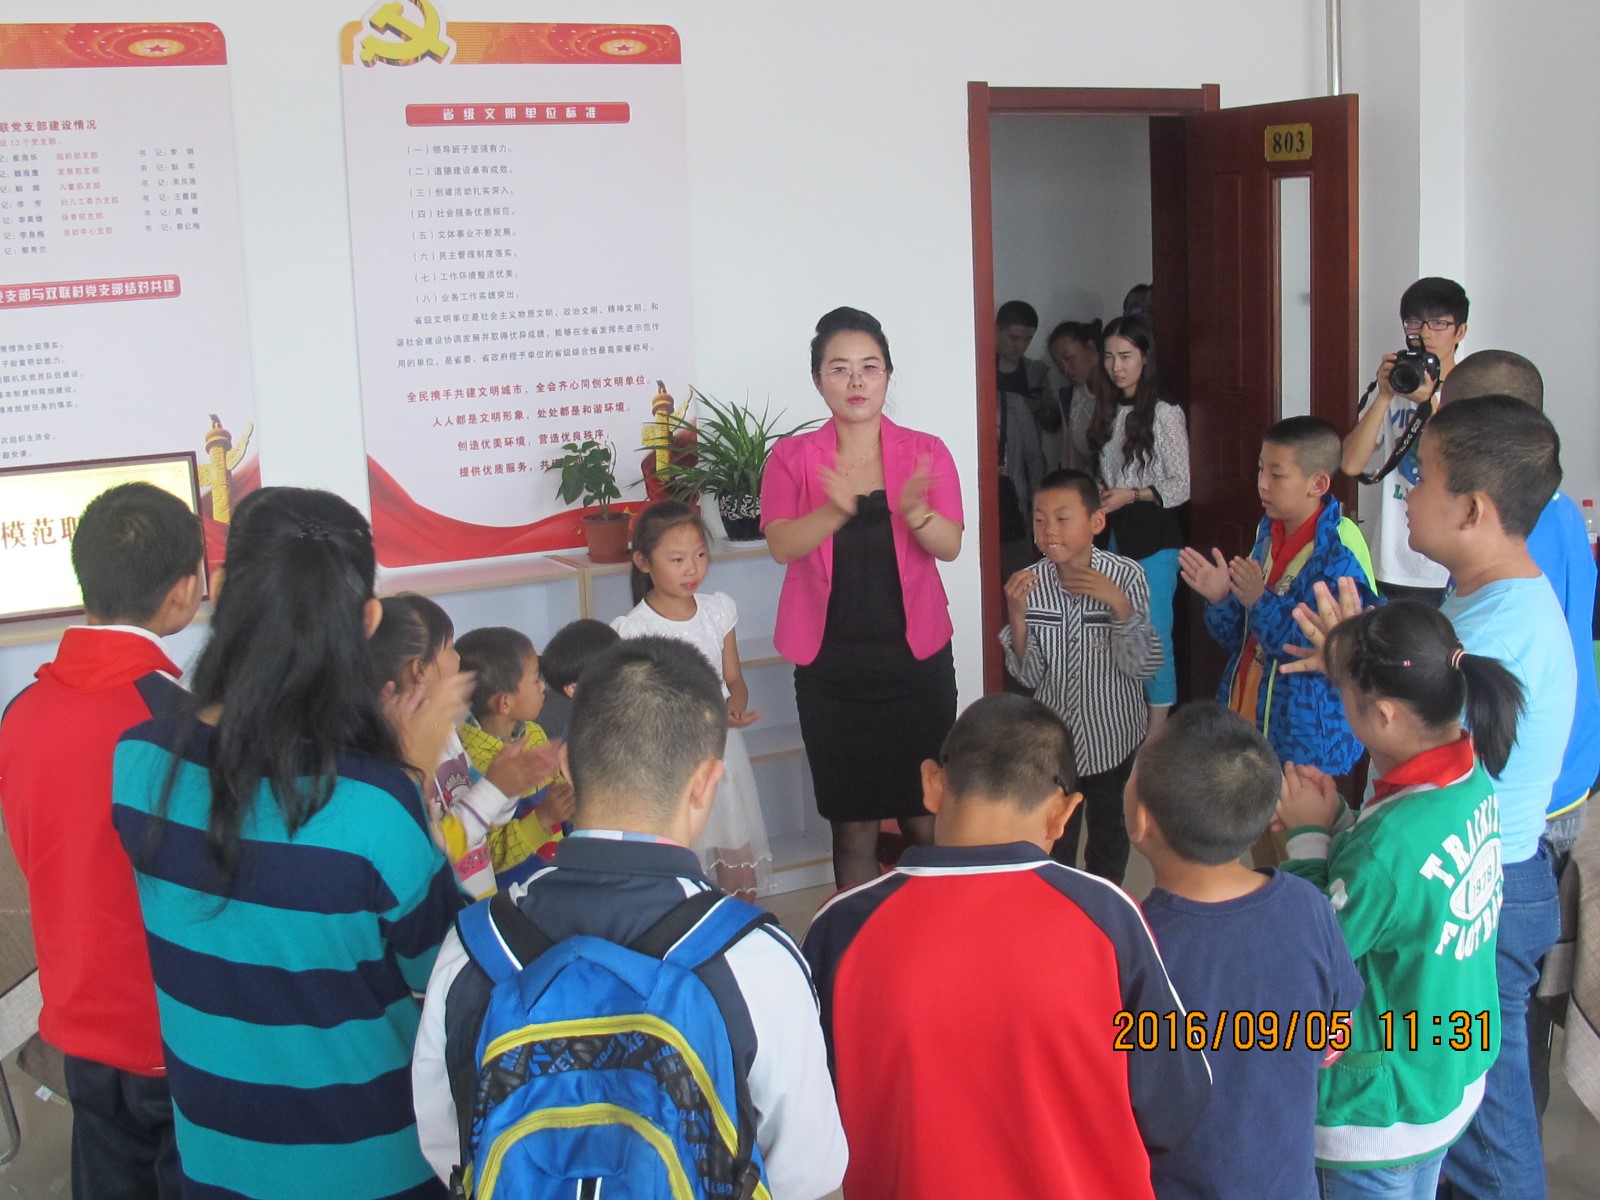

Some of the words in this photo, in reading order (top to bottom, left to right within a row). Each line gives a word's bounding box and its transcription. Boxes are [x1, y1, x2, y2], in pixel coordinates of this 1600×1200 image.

[443, 106, 597, 121] 省级文明单位标准
[1273, 131, 1305, 153] 803
[0, 370, 83, 384] 联机关党员队伍建设。
[407, 374, 653, 403] 全民携手共建文明城市，全会齐心同创文明单位。
[432, 401, 631, 428] 人人都是文明形象，处处都是和谐环境。
[458, 429, 610, 452] 创造优美环境，营造优良秩序，
